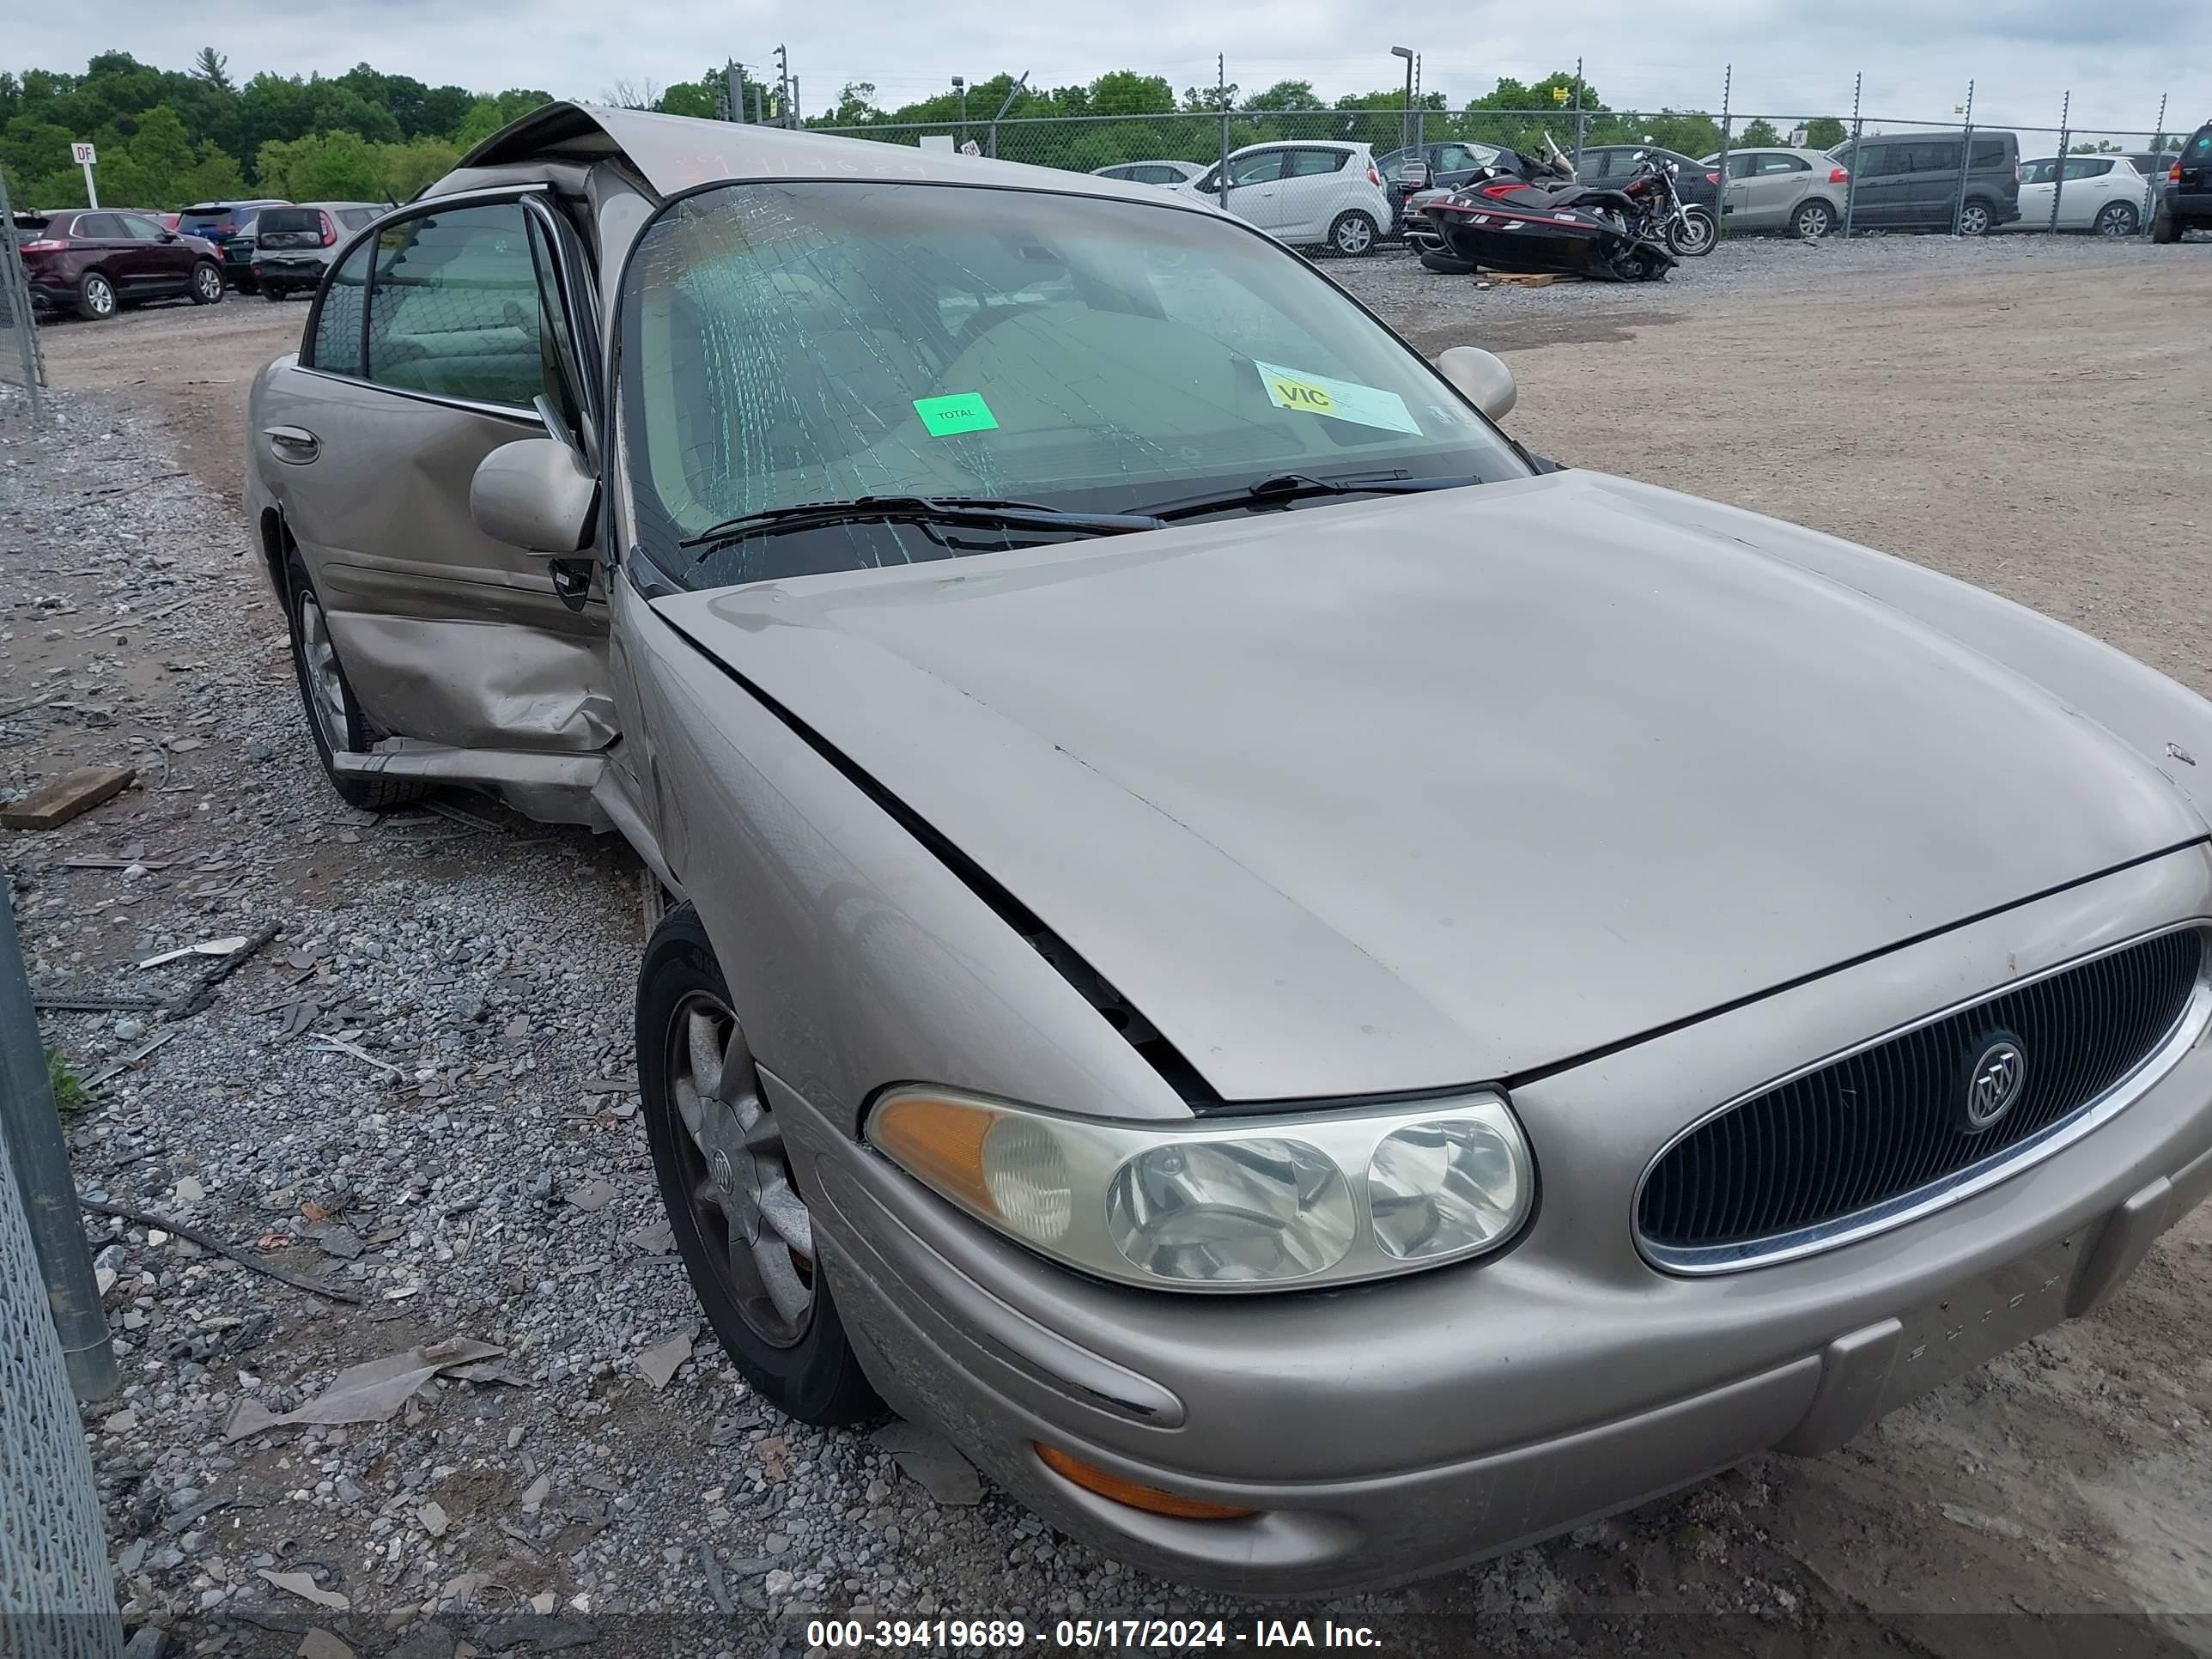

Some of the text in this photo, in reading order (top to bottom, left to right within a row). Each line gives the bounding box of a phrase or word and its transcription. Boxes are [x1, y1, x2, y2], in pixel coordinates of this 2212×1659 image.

[77, 146, 91, 161] DF
[1277, 384, 1329, 406] VIC
[936, 409, 976, 420] TOTAL
